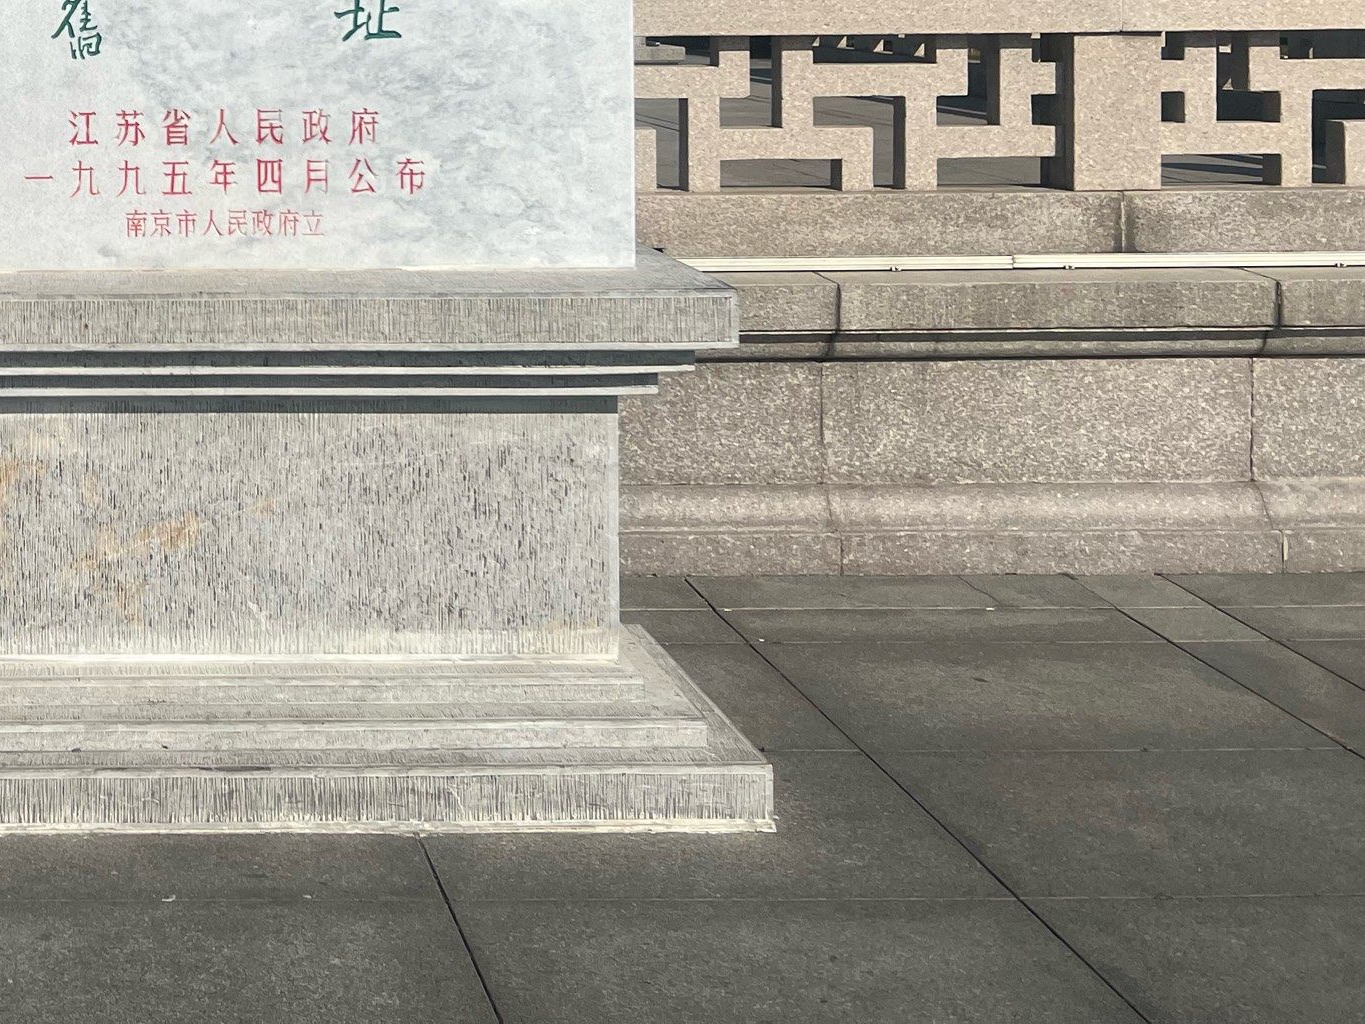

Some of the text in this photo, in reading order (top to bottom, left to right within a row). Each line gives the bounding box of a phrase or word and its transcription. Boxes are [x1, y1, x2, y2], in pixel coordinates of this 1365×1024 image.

[69, 108, 379, 148] 江苏省人民政府
[24, 157, 426, 197] 一九九五年四月公布
[125, 209, 325, 237] 南京市人民政府立
